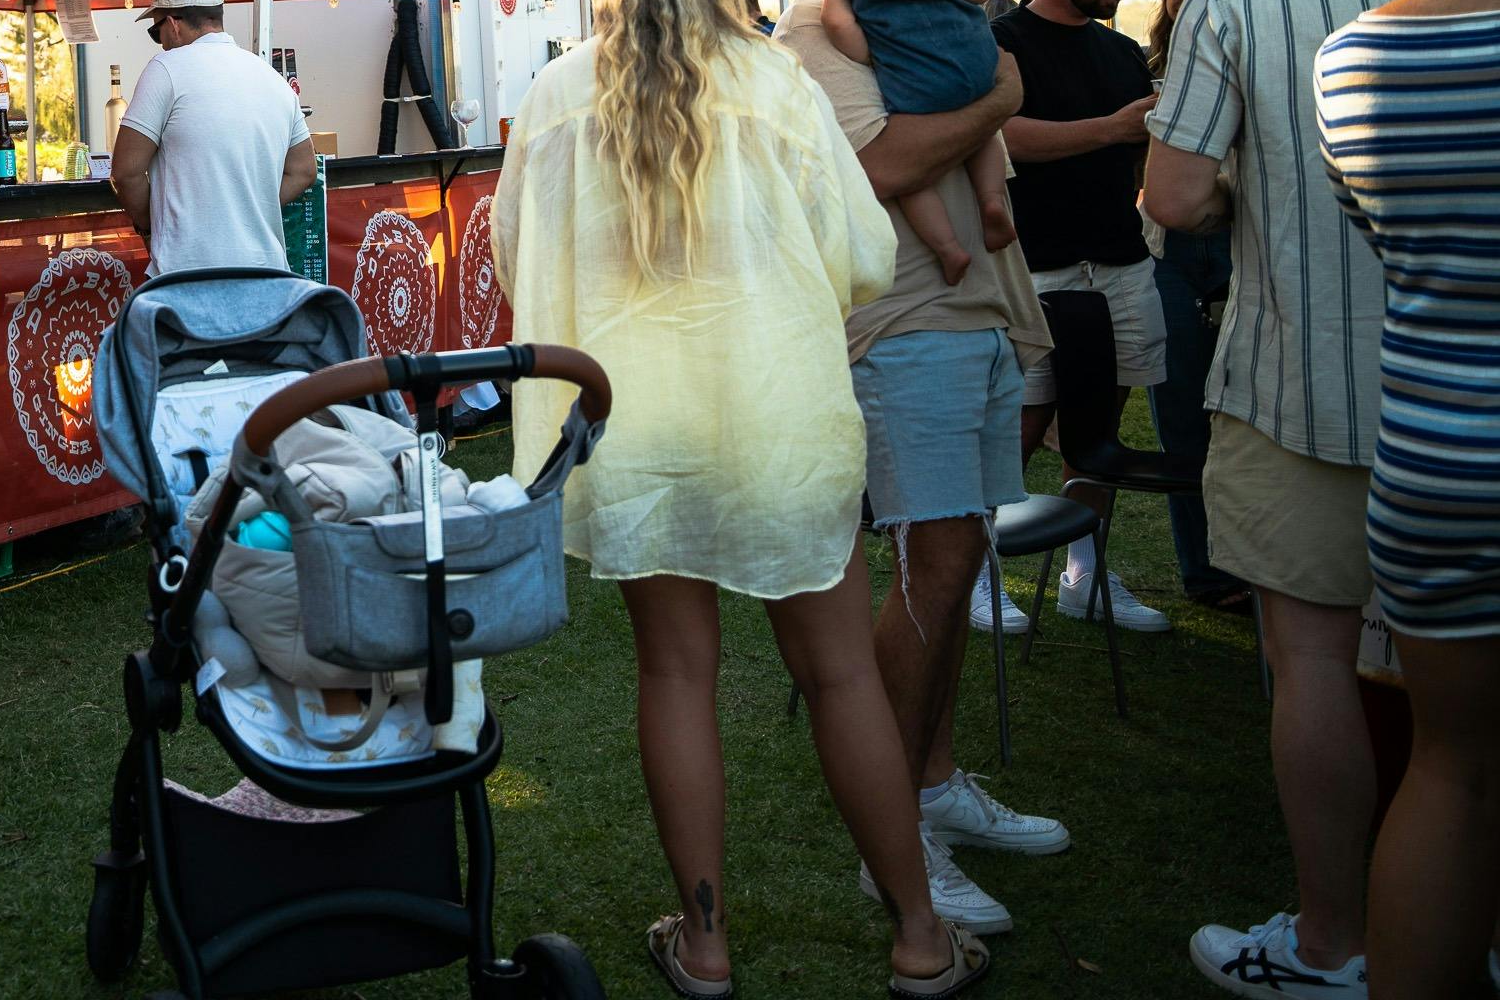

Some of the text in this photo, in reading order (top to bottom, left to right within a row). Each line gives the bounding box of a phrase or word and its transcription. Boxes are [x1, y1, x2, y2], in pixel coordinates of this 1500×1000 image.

[368, 229, 426, 279] DIABLO
[26, 271, 120, 336] DIABLO
[32, 393, 93, 455] GINGER
